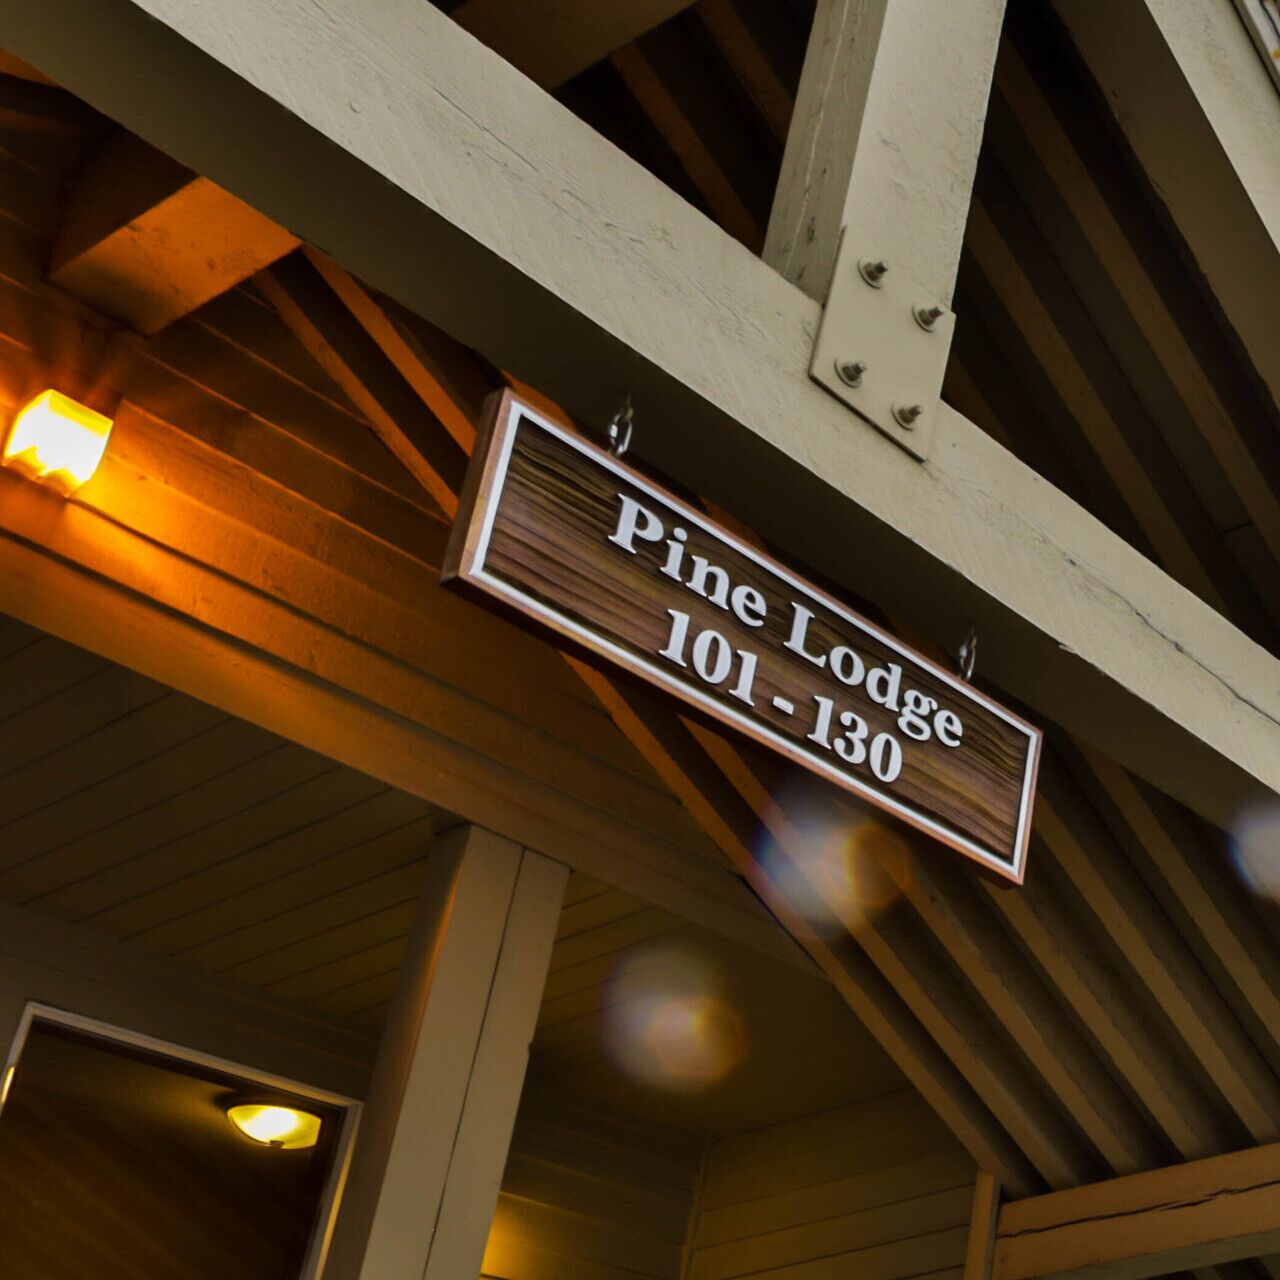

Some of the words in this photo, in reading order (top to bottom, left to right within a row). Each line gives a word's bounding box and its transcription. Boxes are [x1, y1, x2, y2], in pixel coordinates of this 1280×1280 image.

[608, 493, 767, 627] Pine
[783, 602, 963, 748] Lodge
[659, 609, 758, 707] 101
[807, 695, 902, 783] 130
